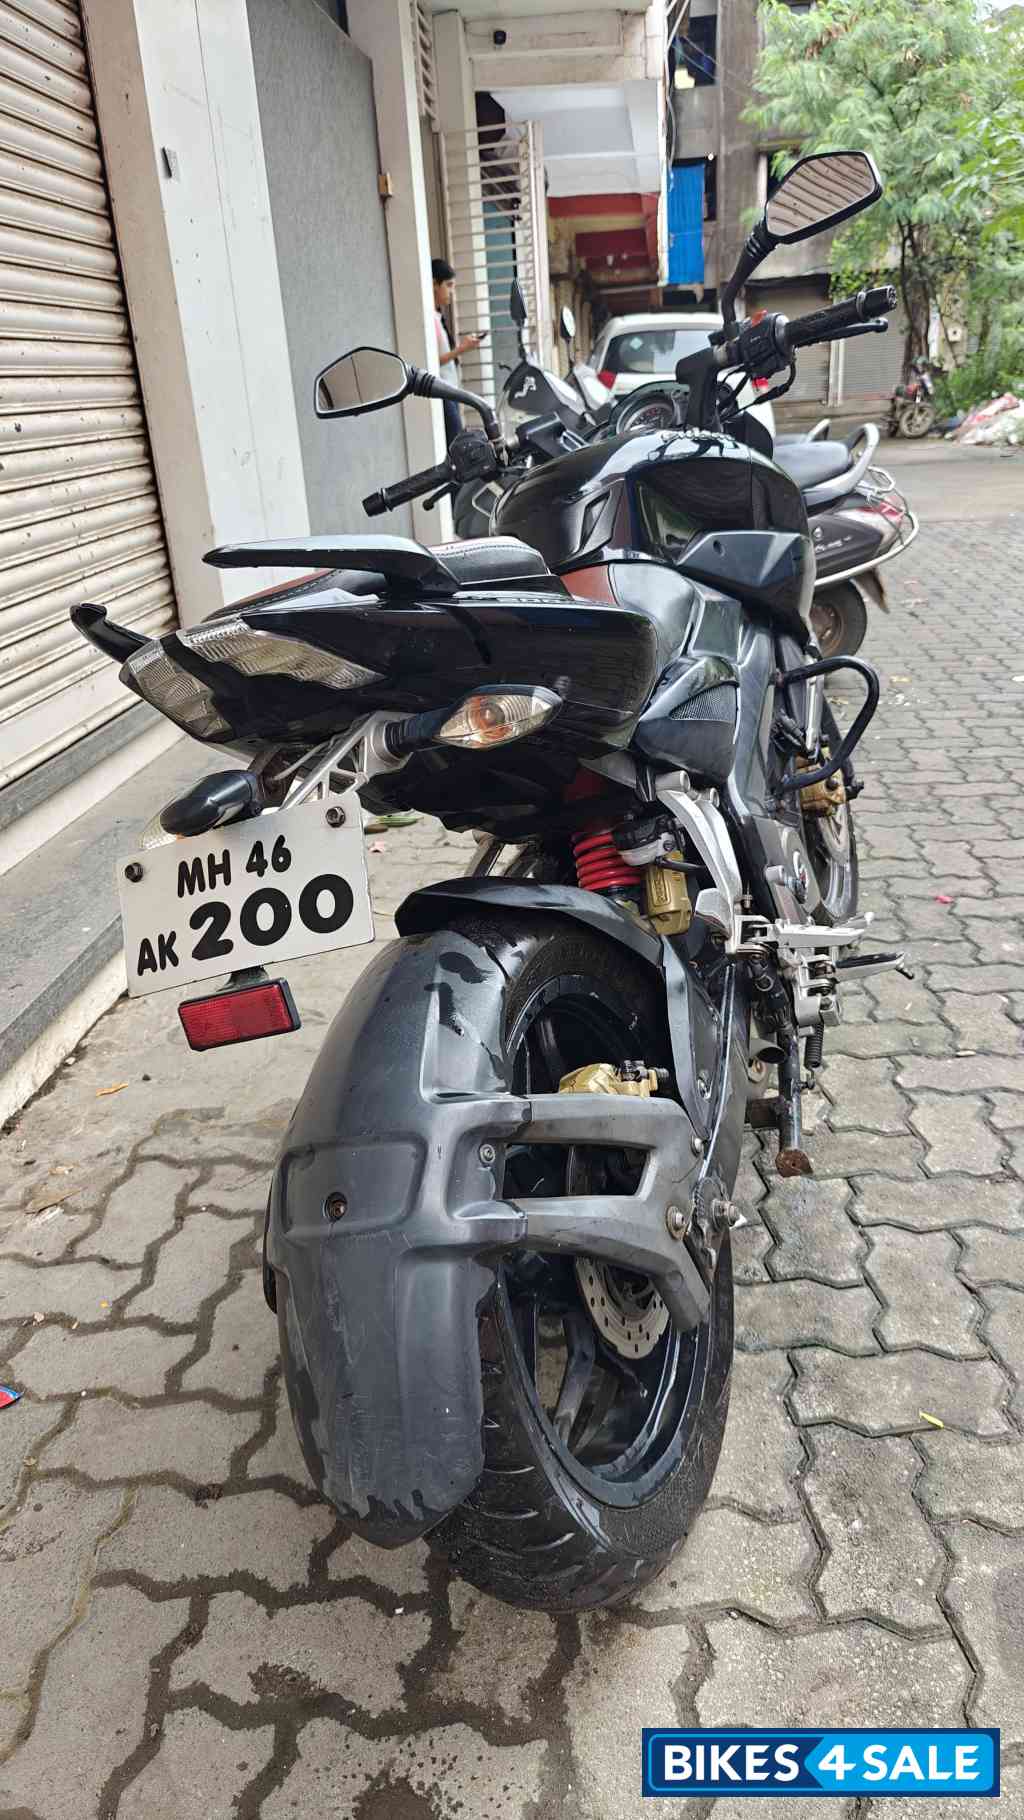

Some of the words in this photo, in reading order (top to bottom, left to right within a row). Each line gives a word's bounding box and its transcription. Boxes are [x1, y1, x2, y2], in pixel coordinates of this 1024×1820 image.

[177, 849, 231, 898] MH
[246, 835, 292, 877] 46
[137, 931, 179, 976] AK
[189, 873, 354, 961] 200
